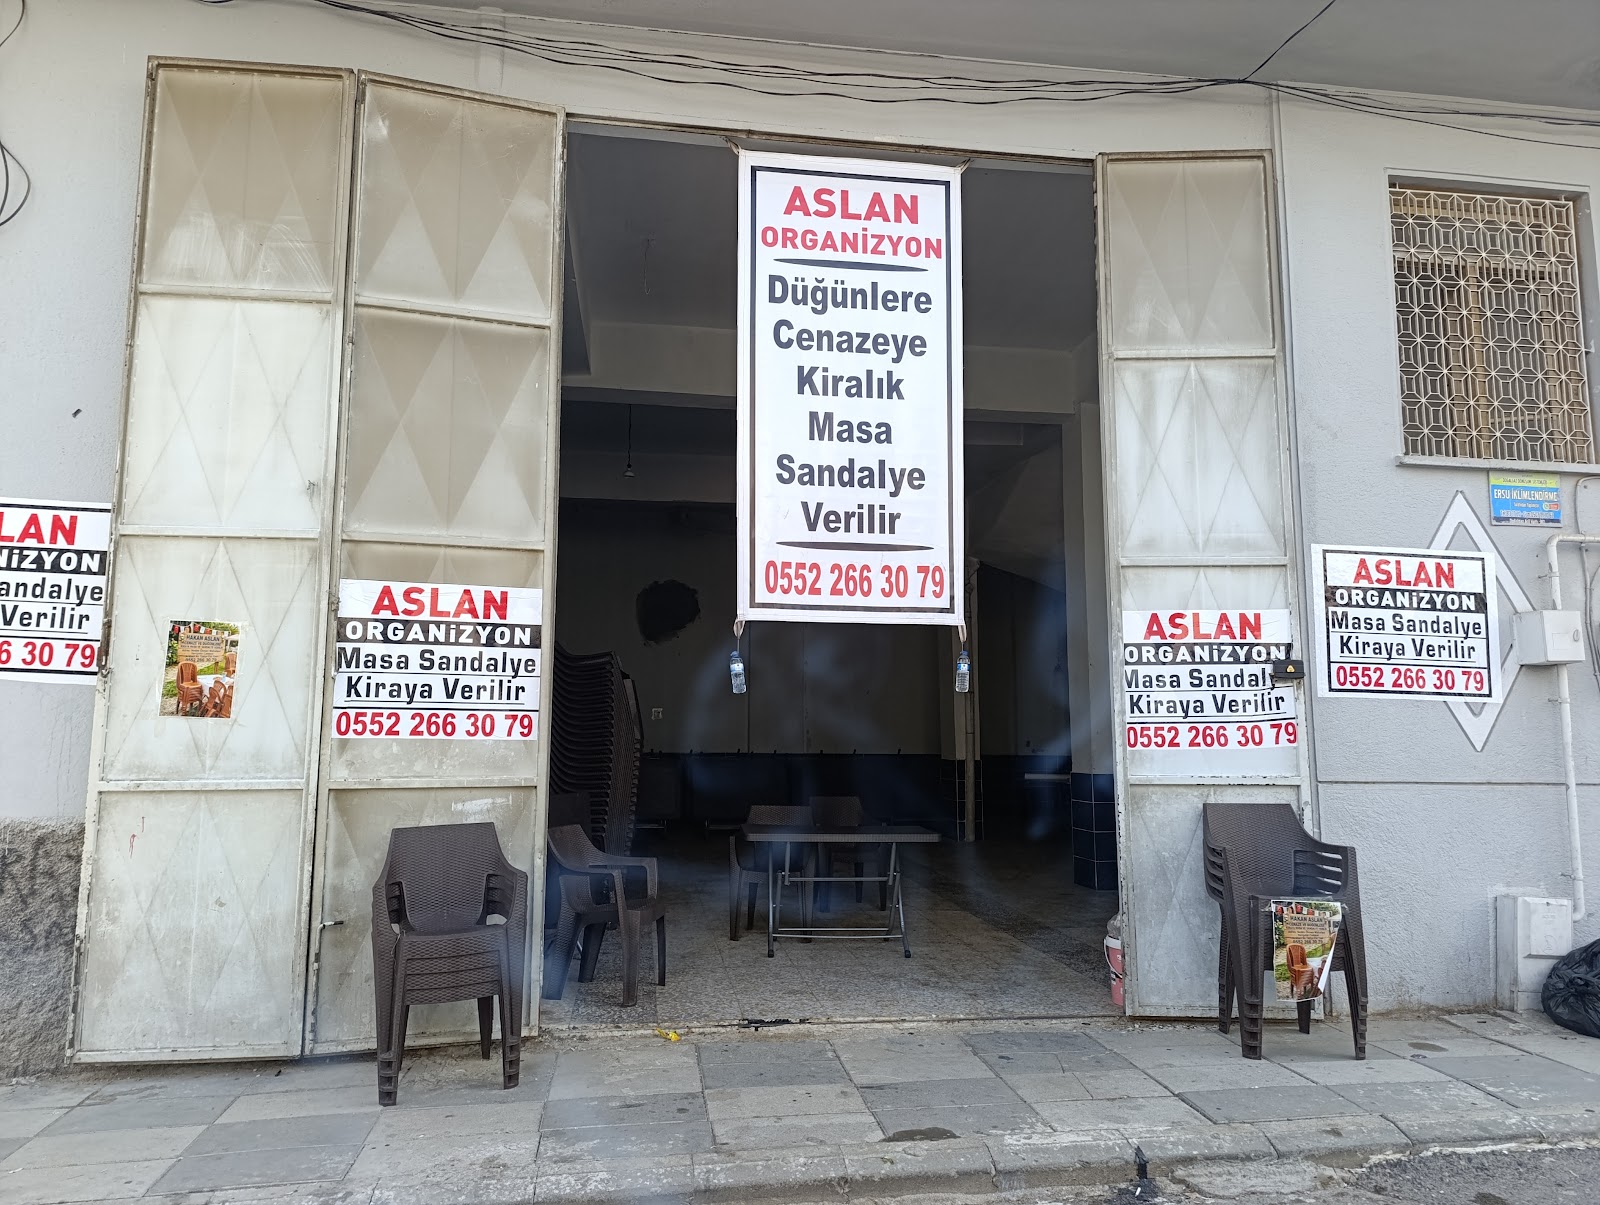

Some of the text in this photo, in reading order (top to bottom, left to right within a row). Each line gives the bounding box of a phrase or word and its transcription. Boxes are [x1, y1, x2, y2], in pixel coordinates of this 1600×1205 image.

[784, 186, 918, 224] ASLAN
[761, 226, 942, 259] ORGANİZYON
[769, 275, 932, 315] Düğünlere
[773, 319, 927, 363] Cenazeye
[797, 365, 904, 400] Kiralık
[809, 411, 892, 444] Masa
[776, 454, 926, 498] Sandalye
[1494, 488, 1557, 501] ERSU İKLİMLENDİRME
[801, 501, 901, 534] Verilir
[765, 560, 944, 598] 0552 266 30 79
[1353, 558, 1454, 588] ASLAN
[0, 577, 103, 606] andalye
[371, 585, 508, 620] ASLAN
[1, 605, 89, 629] Verilir
[1144, 613, 1261, 640] ASLAN
[1331, 611, 1481, 639] Masa Sandalye
[22, 642, 53, 667] 30
[65, 644, 95, 668] 79
[1340, 635, 1475, 661] Kiraya Verilir
[338, 647, 536, 679] Masa Sandalye
[346, 676, 525, 704] Kiraya Verilir
[1125, 669, 1180, 688] Masa
[1336, 666, 1484, 691] 0552 266 30 79
[1130, 692, 1285, 719] Kiraya Verilir
[336, 712, 533, 737] 0552 266 30 79
[1127, 722, 1297, 748] 0552 266 30 79
